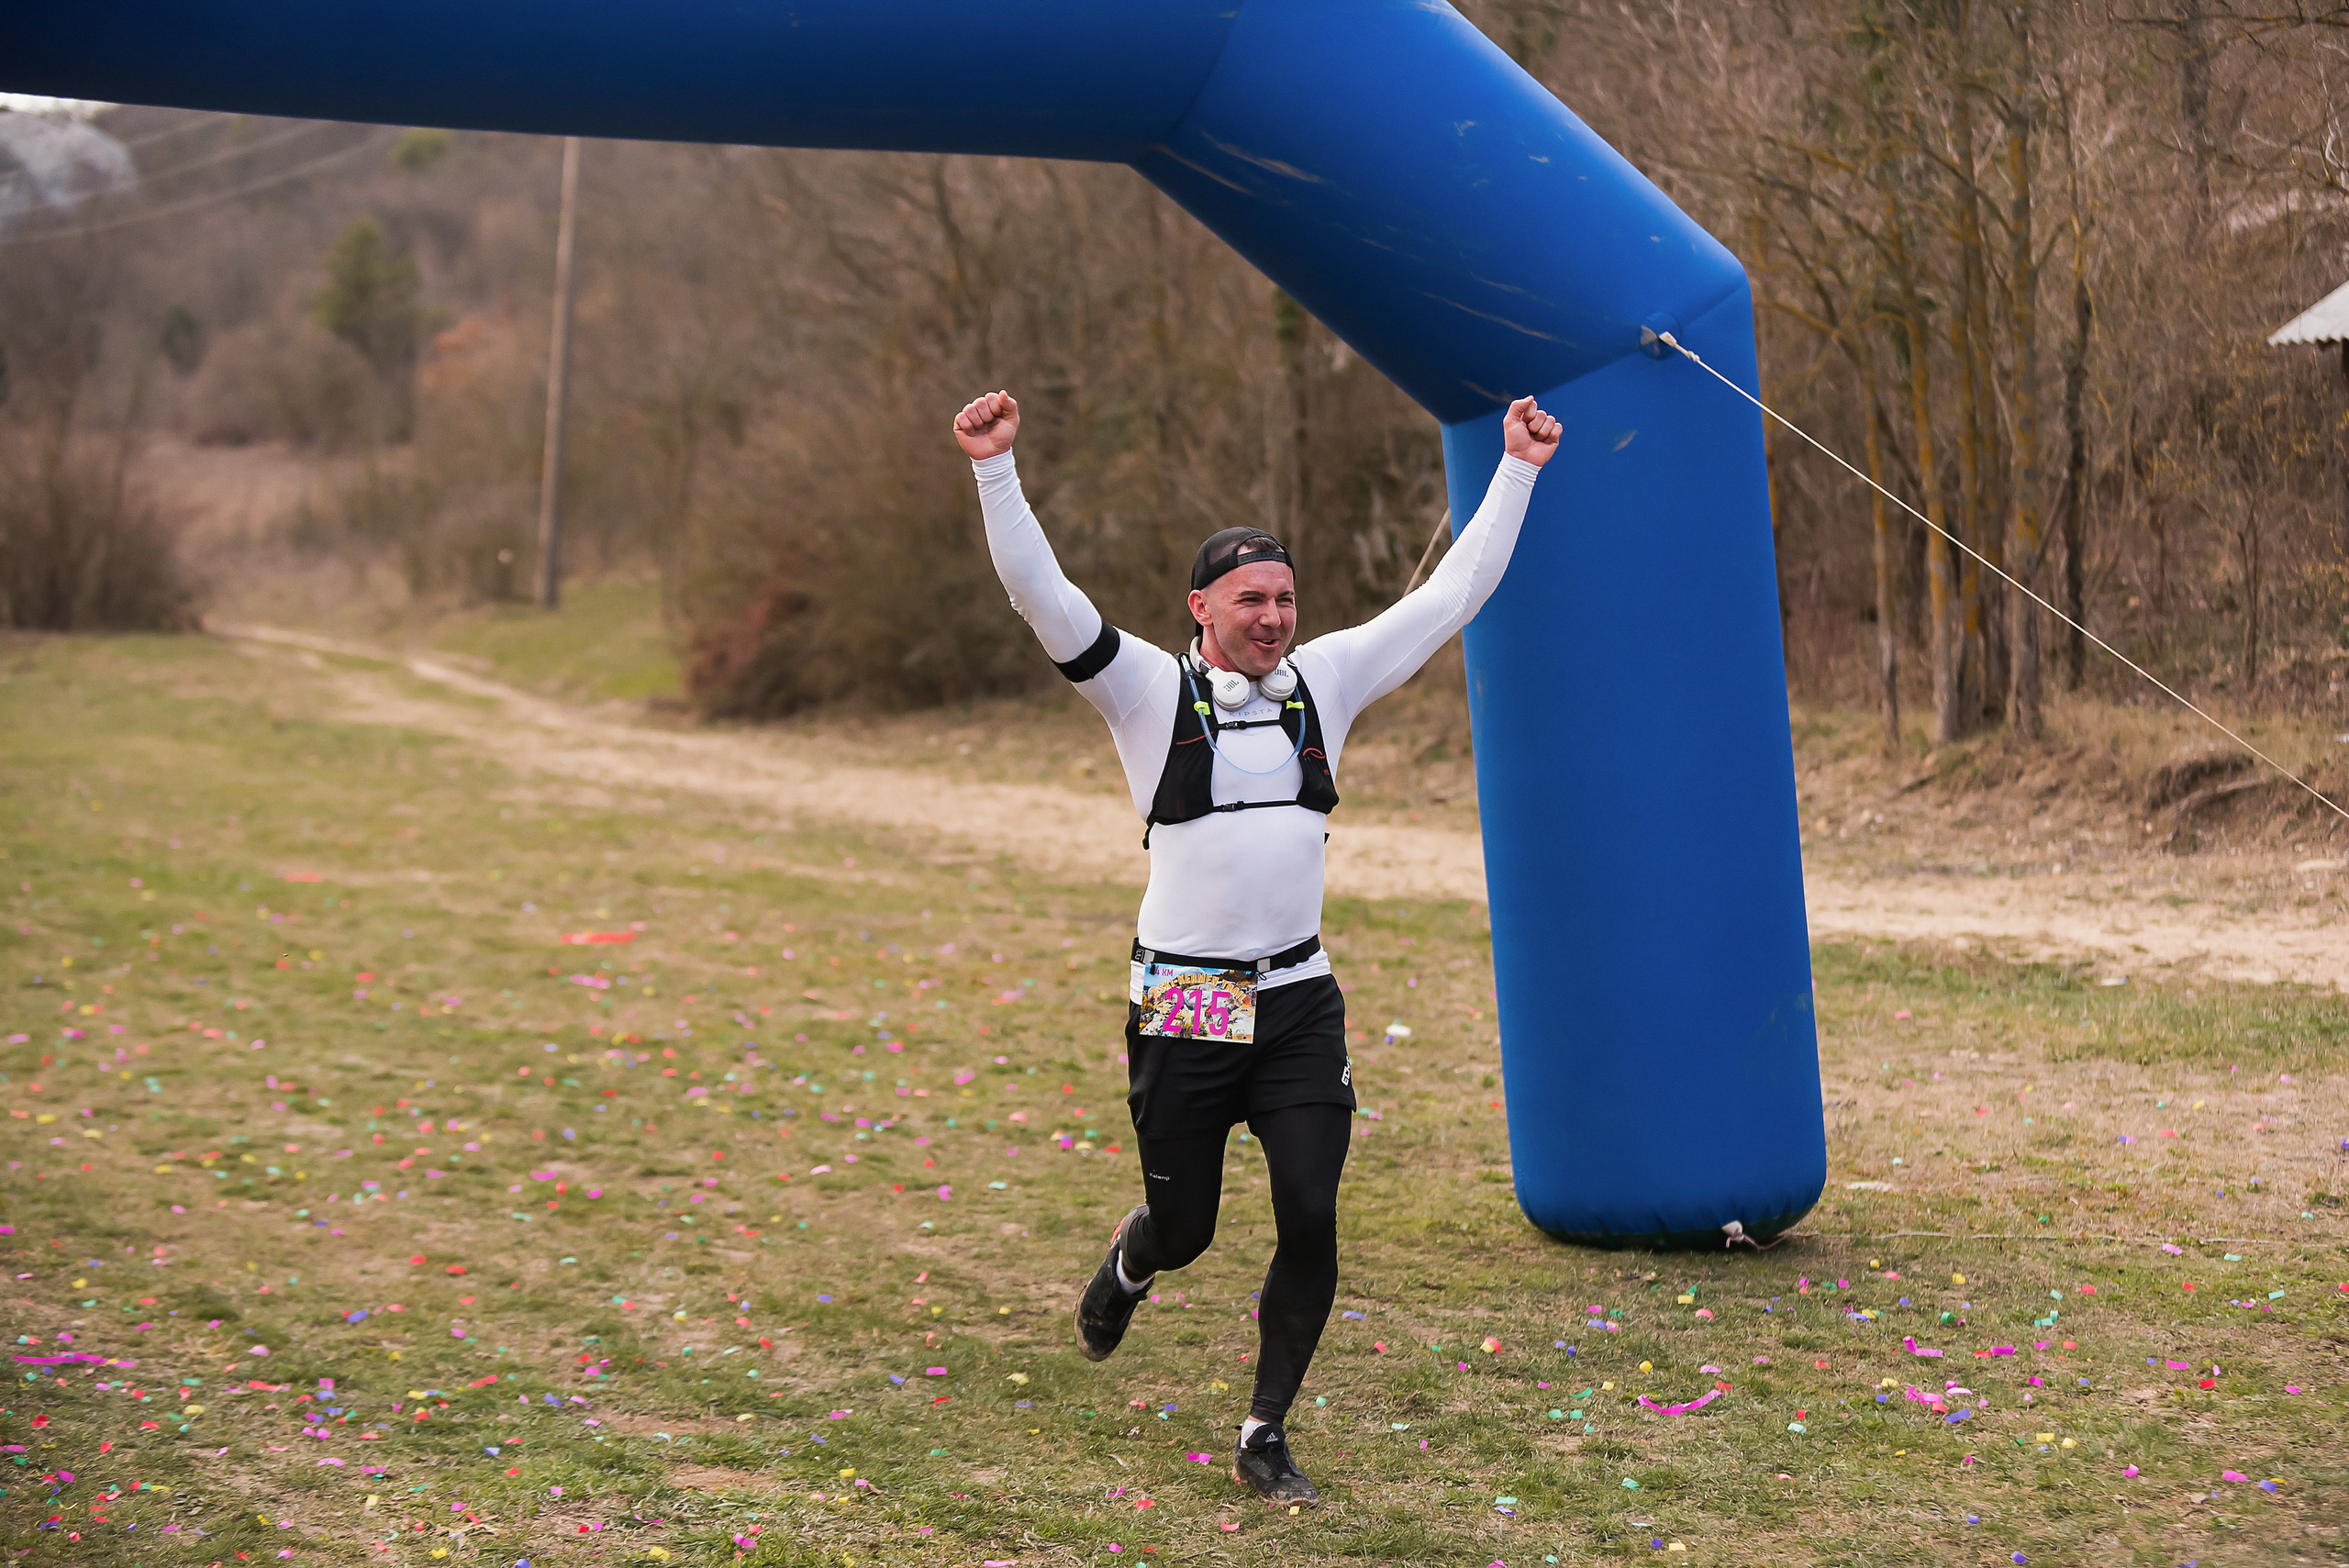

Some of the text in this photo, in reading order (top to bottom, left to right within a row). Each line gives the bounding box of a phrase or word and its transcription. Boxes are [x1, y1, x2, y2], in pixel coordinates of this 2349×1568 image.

[1275, 668, 1289, 678] JBL
[1223, 679, 1240, 693] JBL
[1230, 707, 1273, 717] KIPSTA
[1162, 968, 1174, 977] KM
[1220, 979, 1246, 1003] TRAIL
[1162, 986, 1230, 1036] 215
